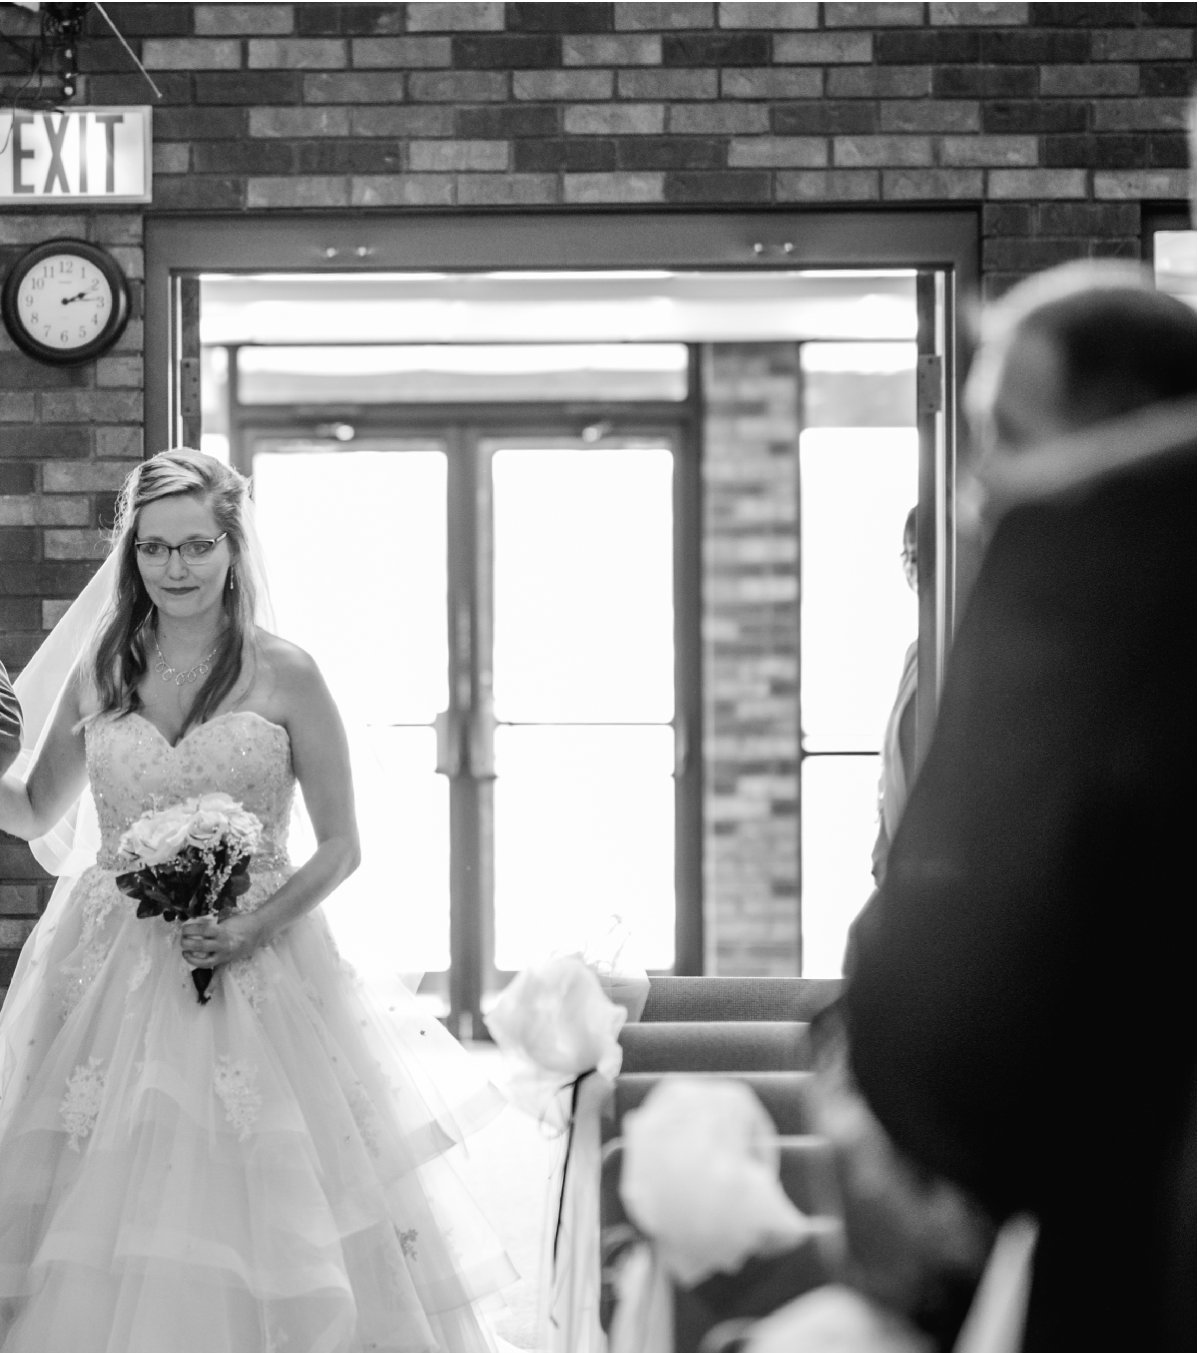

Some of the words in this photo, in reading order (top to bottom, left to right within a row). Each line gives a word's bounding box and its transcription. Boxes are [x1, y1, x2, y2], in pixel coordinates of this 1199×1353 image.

[12, 114, 124, 194] EXIT
[43, 266, 54, 279] 11
[59, 261, 73, 274] 12
[31, 278, 45, 290] 10
[91, 279, 100, 291] 2
[25, 295, 34, 307] 9
[96, 296, 105, 308] 3
[30, 313, 39, 324] 8
[91, 313, 98, 325] 4
[43, 325, 51, 337] 7
[60, 330, 69, 342] 6
[78, 325, 87, 338] 5
